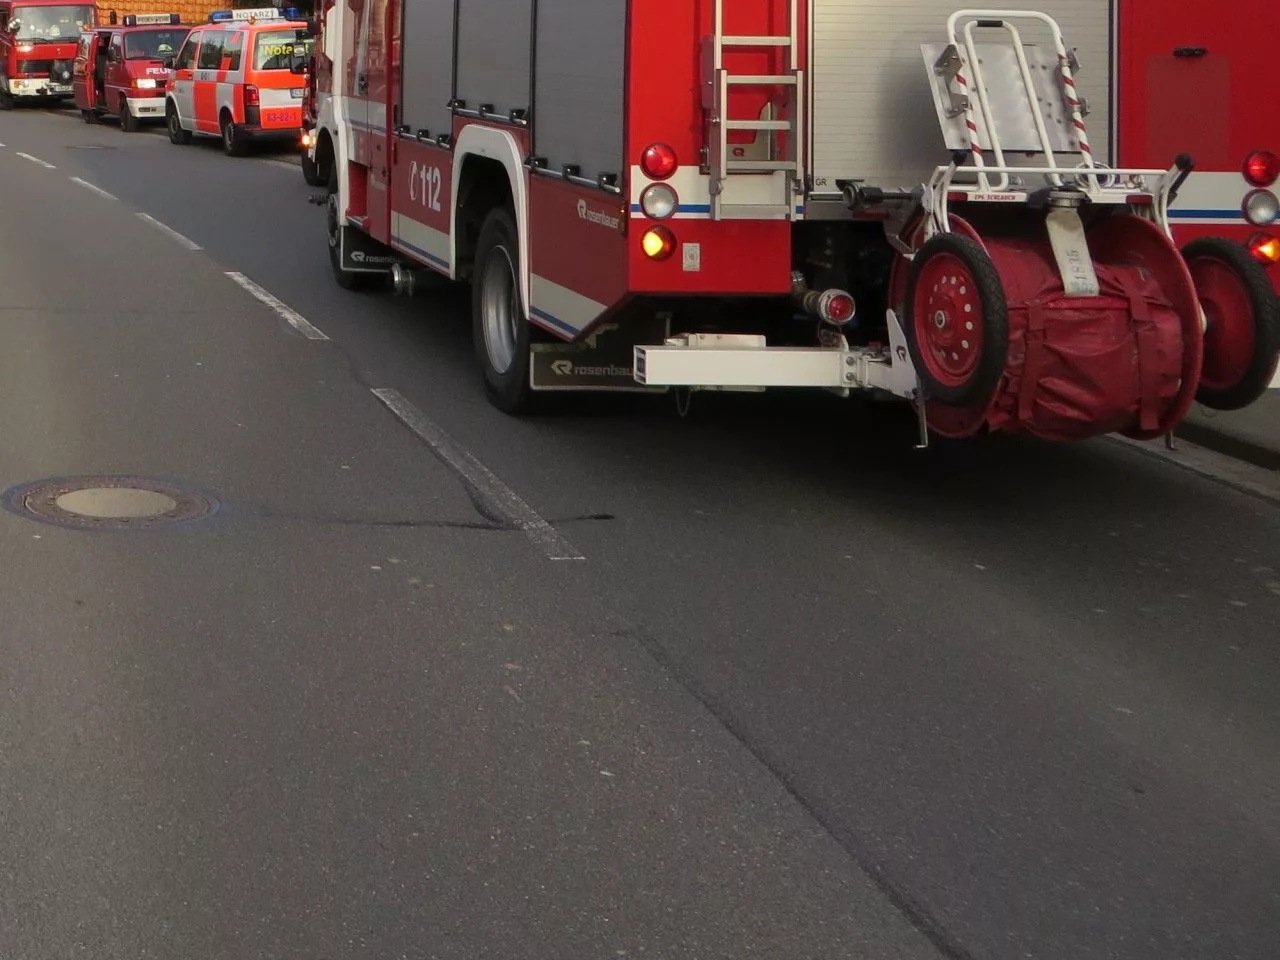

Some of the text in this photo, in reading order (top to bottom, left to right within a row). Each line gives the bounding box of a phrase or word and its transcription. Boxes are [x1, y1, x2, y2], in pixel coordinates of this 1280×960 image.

[236, 10, 274, 19] NOTARZT
[420, 164, 441, 212] 112
[574, 364, 635, 376] rosenbau
